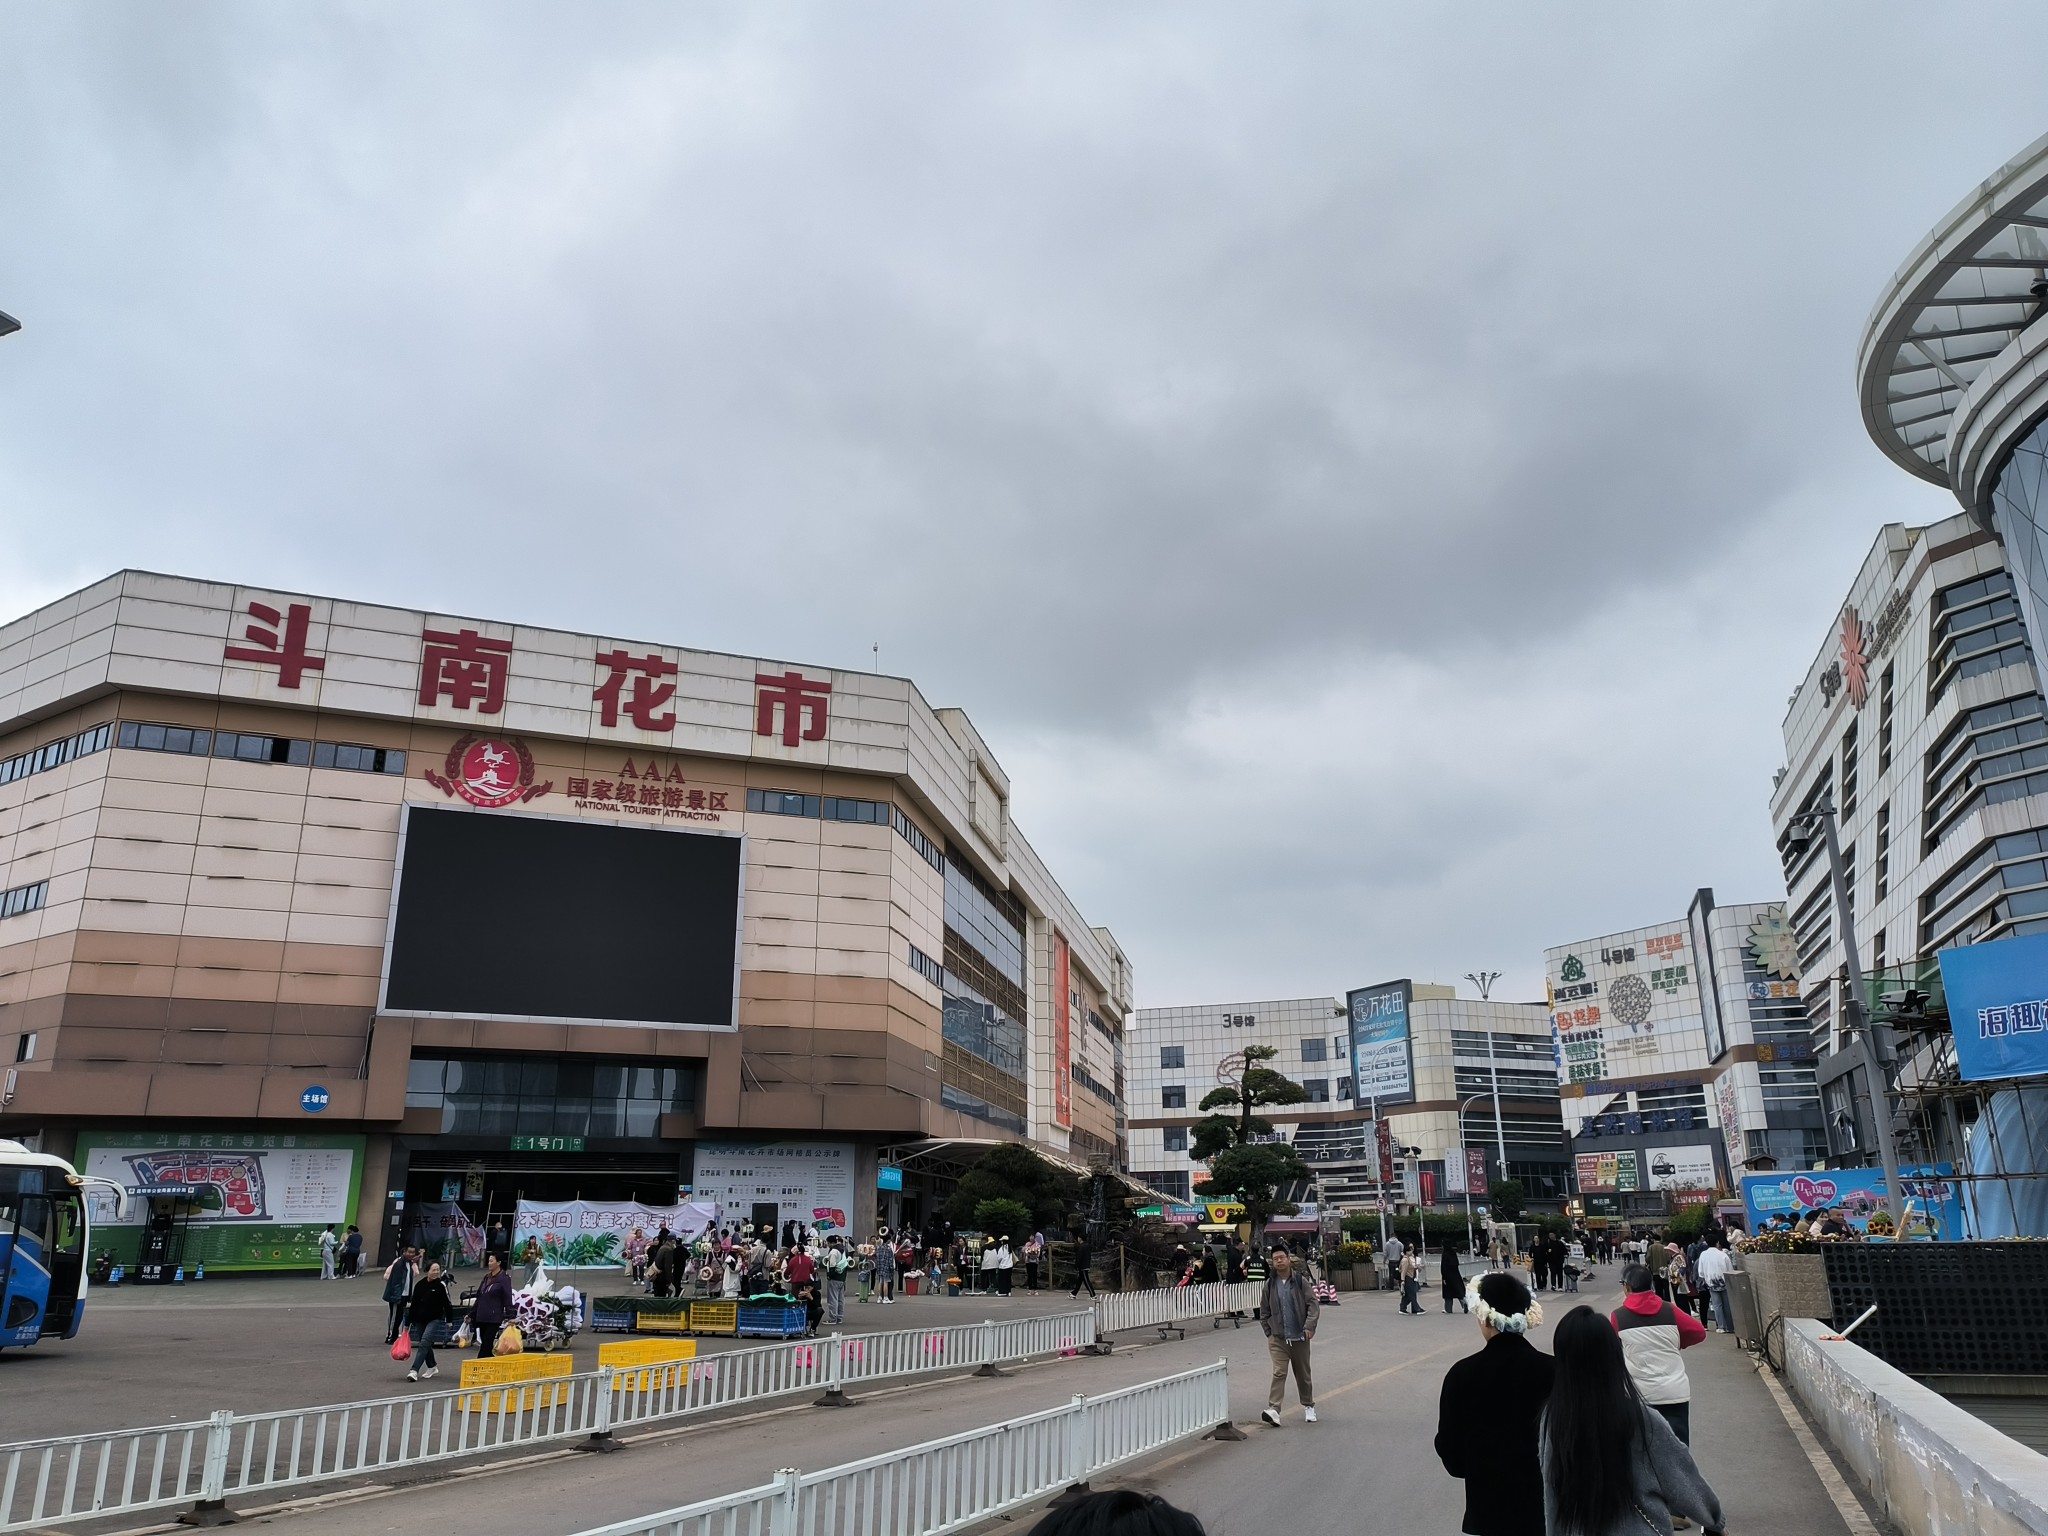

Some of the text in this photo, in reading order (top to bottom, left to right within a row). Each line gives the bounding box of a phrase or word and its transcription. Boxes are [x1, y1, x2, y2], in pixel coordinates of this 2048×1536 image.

[225, 602, 832, 747] 斗南花市
[619, 757, 686, 784] AAA
[567, 776, 729, 811] 国家级旅游景区
[575, 800, 721, 822] NATIONAL TOURIST ATTRACTION
[1601, 948, 1635, 966] 4号馆
[1368, 991, 1404, 1018] 万花田
[1222, 1013, 1255, 1028] 3号馆
[302, 1094, 328, 1103] 主场馆
[155, 1135, 297, 1147] 斗南花市导览图
[528, 1137, 564, 1150] 1号门
[708, 1149, 841, 1158] 昆明斗南花卉市场网格员公示牌
[1795, 1182, 1834, 1197] 打卡攻略
[1378, 1199, 1384, 1207] 5
[143, 1265, 161, 1274] 特警
